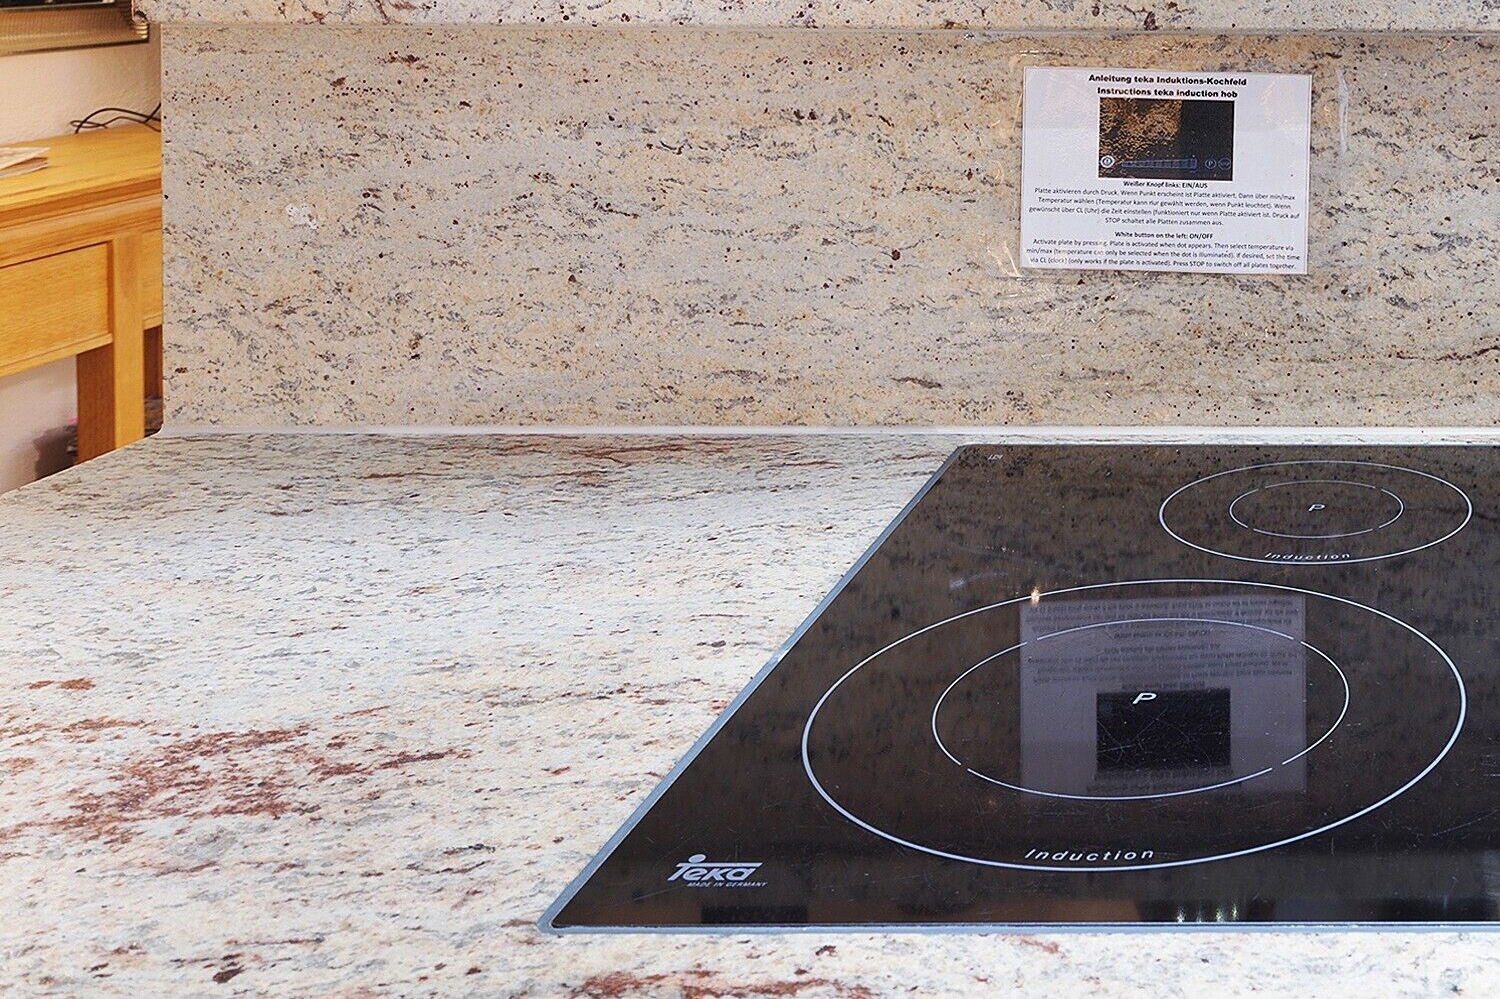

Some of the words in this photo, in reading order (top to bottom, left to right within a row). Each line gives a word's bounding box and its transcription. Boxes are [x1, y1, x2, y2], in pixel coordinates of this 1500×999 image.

[1088, 73, 1132, 85] Anleitung
[1134, 74, 1155, 84] teka
[1156, 75, 1247, 87] Induktions-Kochfeld
[1097, 86, 1152, 97] Instructions
[1153, 88, 1175, 97] teka
[1176, 88, 1219, 99] induction
[1220, 90, 1238, 99] hob
[1123, 180, 1145, 188] Weißer
[1146, 181, 1165, 190] Knopf
[1165, 181, 1181, 189] links:
[1181, 181, 1208, 191] EIN/AUS
[1114, 230, 1133, 238] White
[1134, 231, 1155, 239] button
[1164, 231, 1175, 239] the
[1175, 231, 1189, 239] left:
[1189, 232, 1213, 240] ON/OFF
[1264, 552, 1350, 560] Induction
[1132, 692, 1157, 705] P
[1024, 848, 1154, 862] Induction
